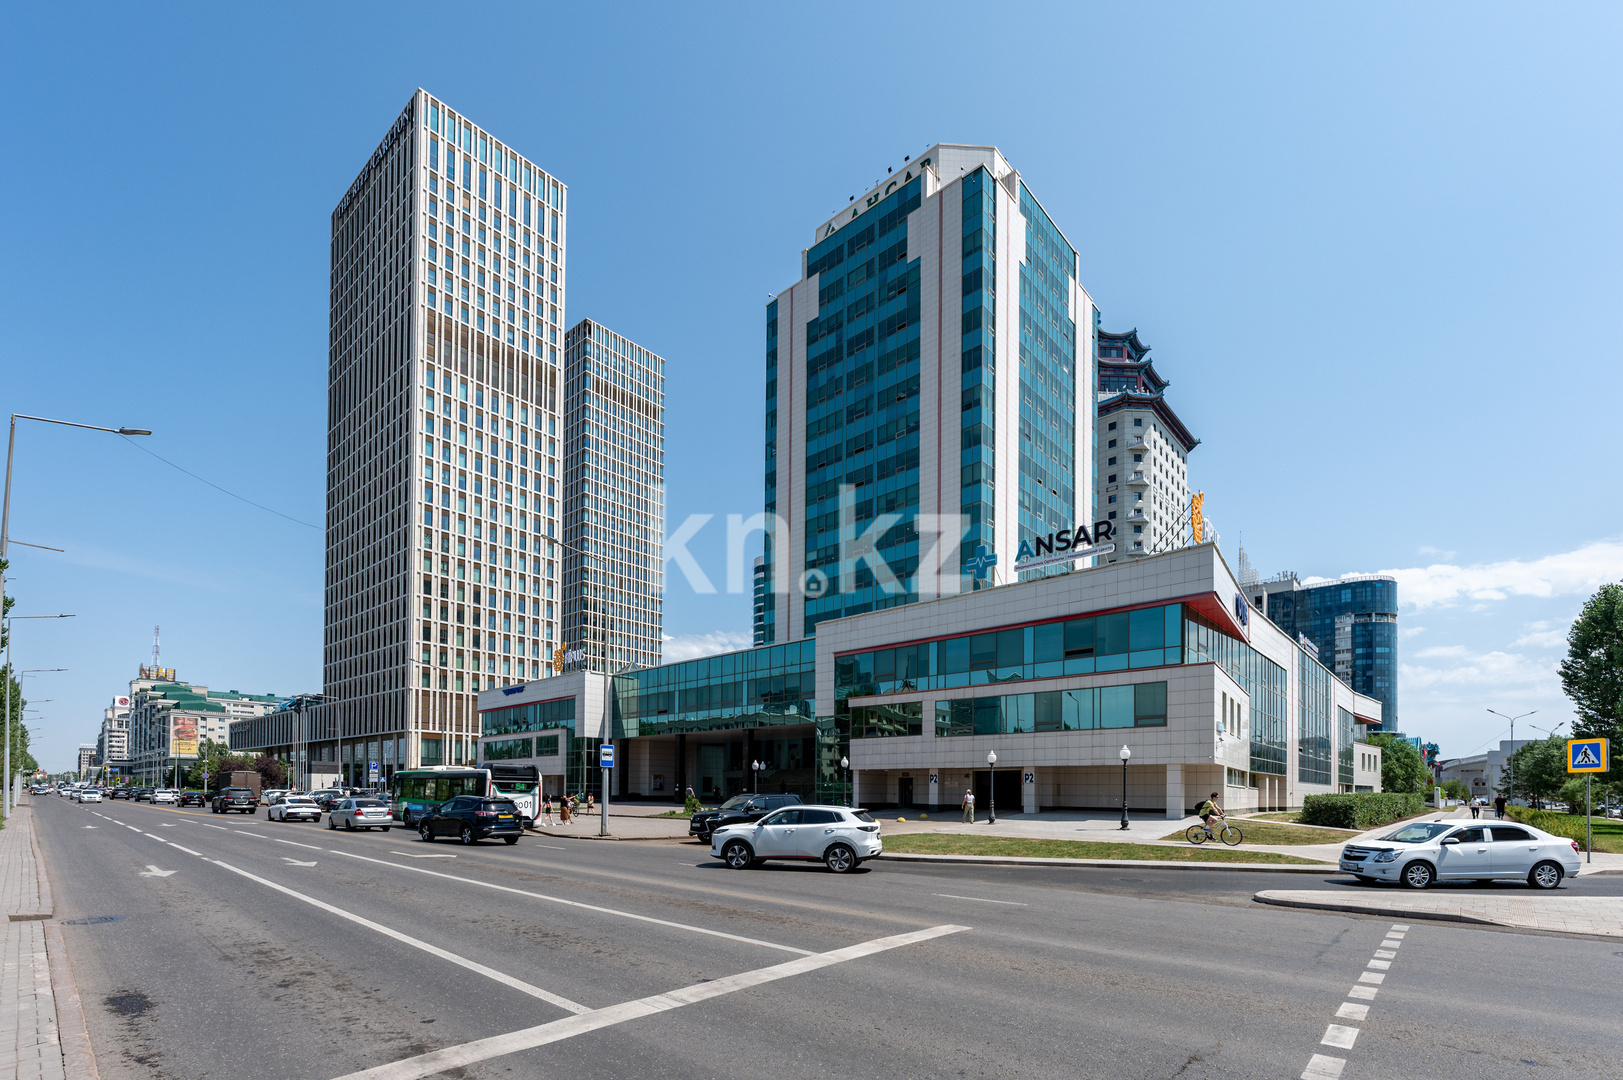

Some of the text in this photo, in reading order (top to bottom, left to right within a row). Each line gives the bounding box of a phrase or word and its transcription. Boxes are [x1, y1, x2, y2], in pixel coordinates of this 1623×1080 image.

[1015, 520, 1113, 562] ANSAR
[930, 774, 938, 784] P2
[1025, 772, 1034, 783] P2
[515, 782, 525, 790] 54
